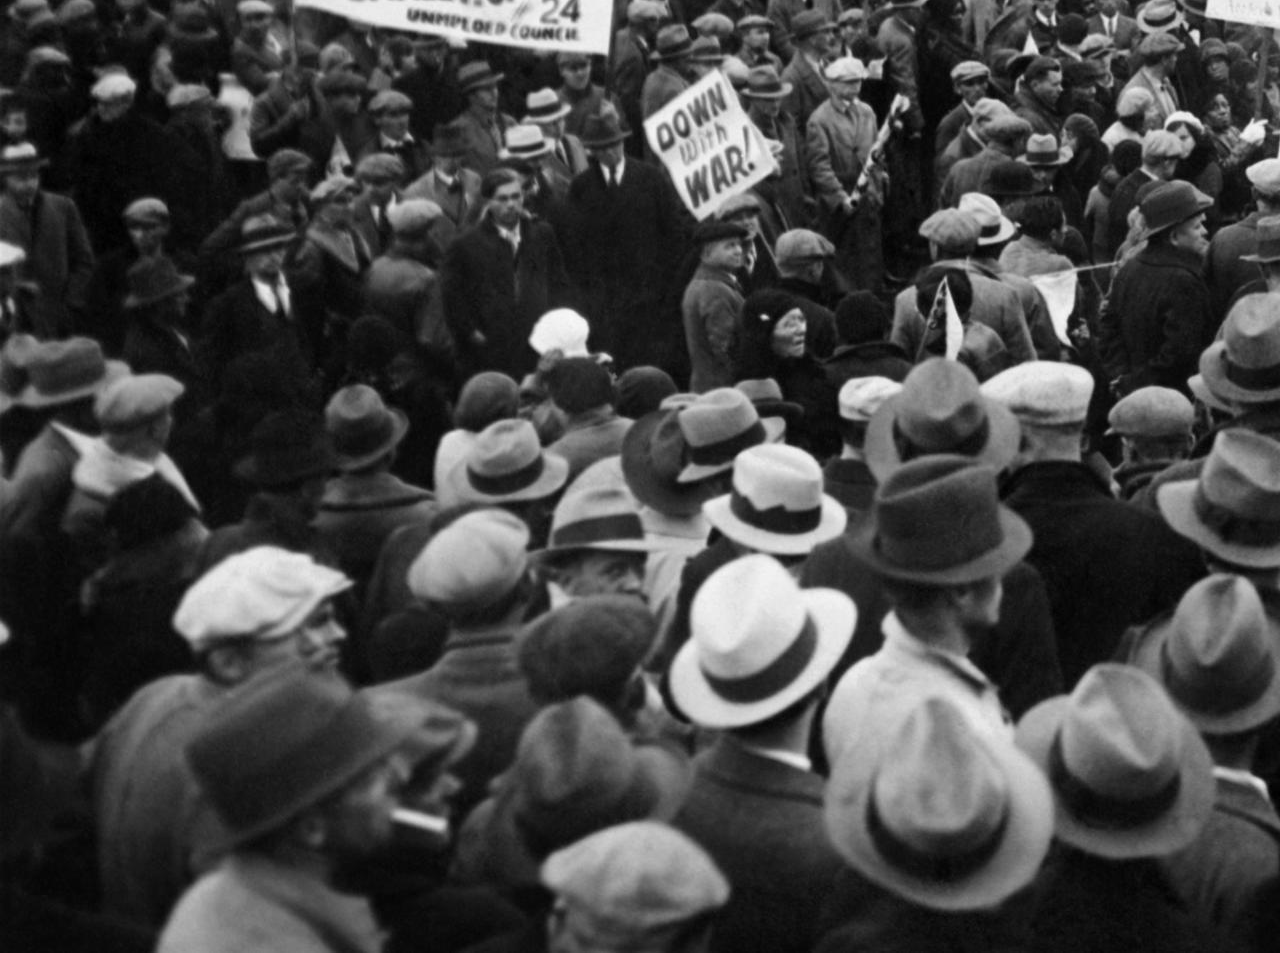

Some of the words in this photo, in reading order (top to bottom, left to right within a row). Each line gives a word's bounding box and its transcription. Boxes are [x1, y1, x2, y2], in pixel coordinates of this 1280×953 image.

[656, 81, 728, 154] DOWN
[679, 122, 728, 166] with
[685, 125, 756, 209] WAR!
